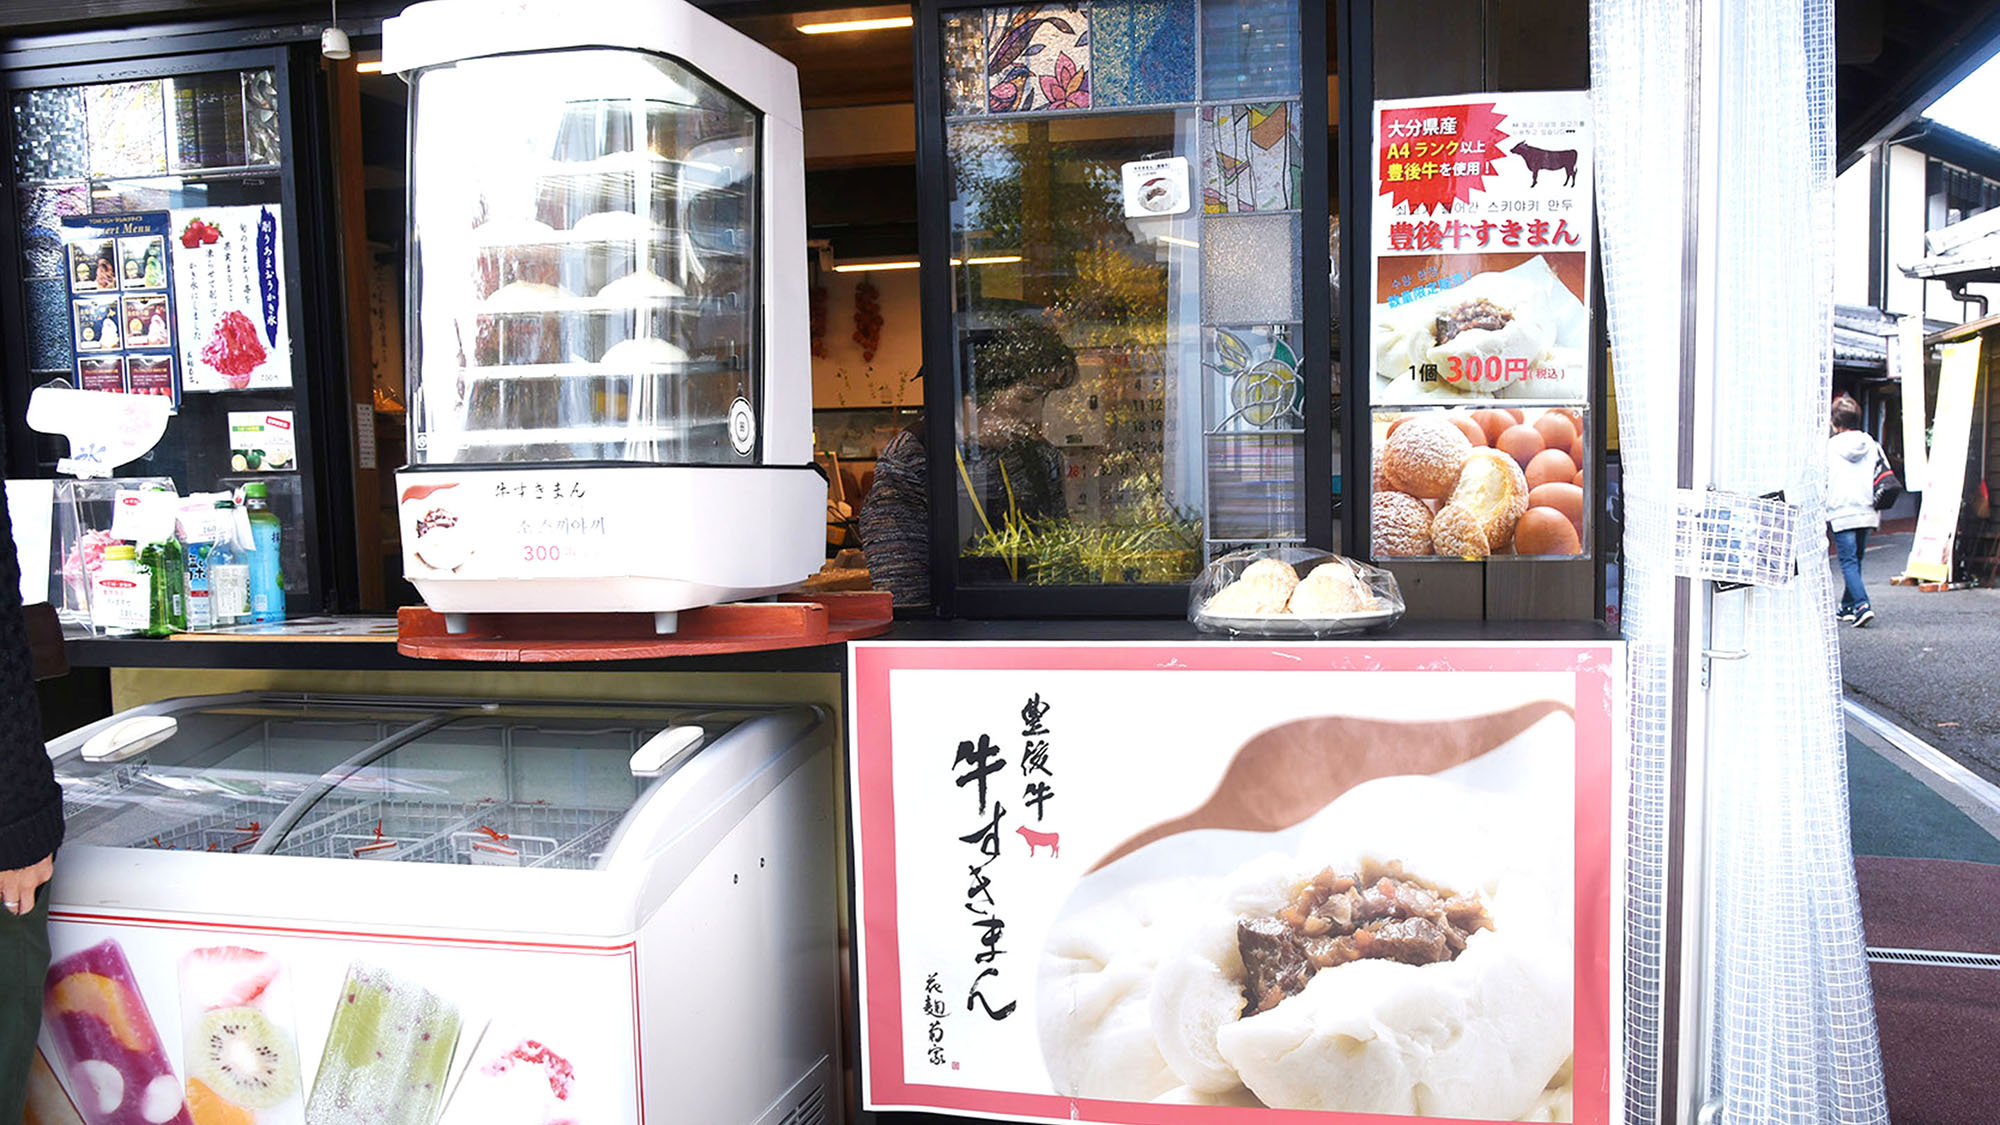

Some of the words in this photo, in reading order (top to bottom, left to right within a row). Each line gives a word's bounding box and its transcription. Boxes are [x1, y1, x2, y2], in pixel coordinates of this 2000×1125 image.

[1388, 117, 1457, 138] 大分県産
[1387, 143, 1410, 160] A4
[1414, 140, 1486, 158] ランク以上
[122, 223, 151, 235] Menu
[1387, 218, 1580, 251] 豊後牛すきまん
[1409, 363, 1438, 383] 1個
[495, 481, 586, 500] 牛すきまん
[1021, 692, 1053, 822] 豊後牛
[952, 733, 1017, 1021] 牛すきまん
